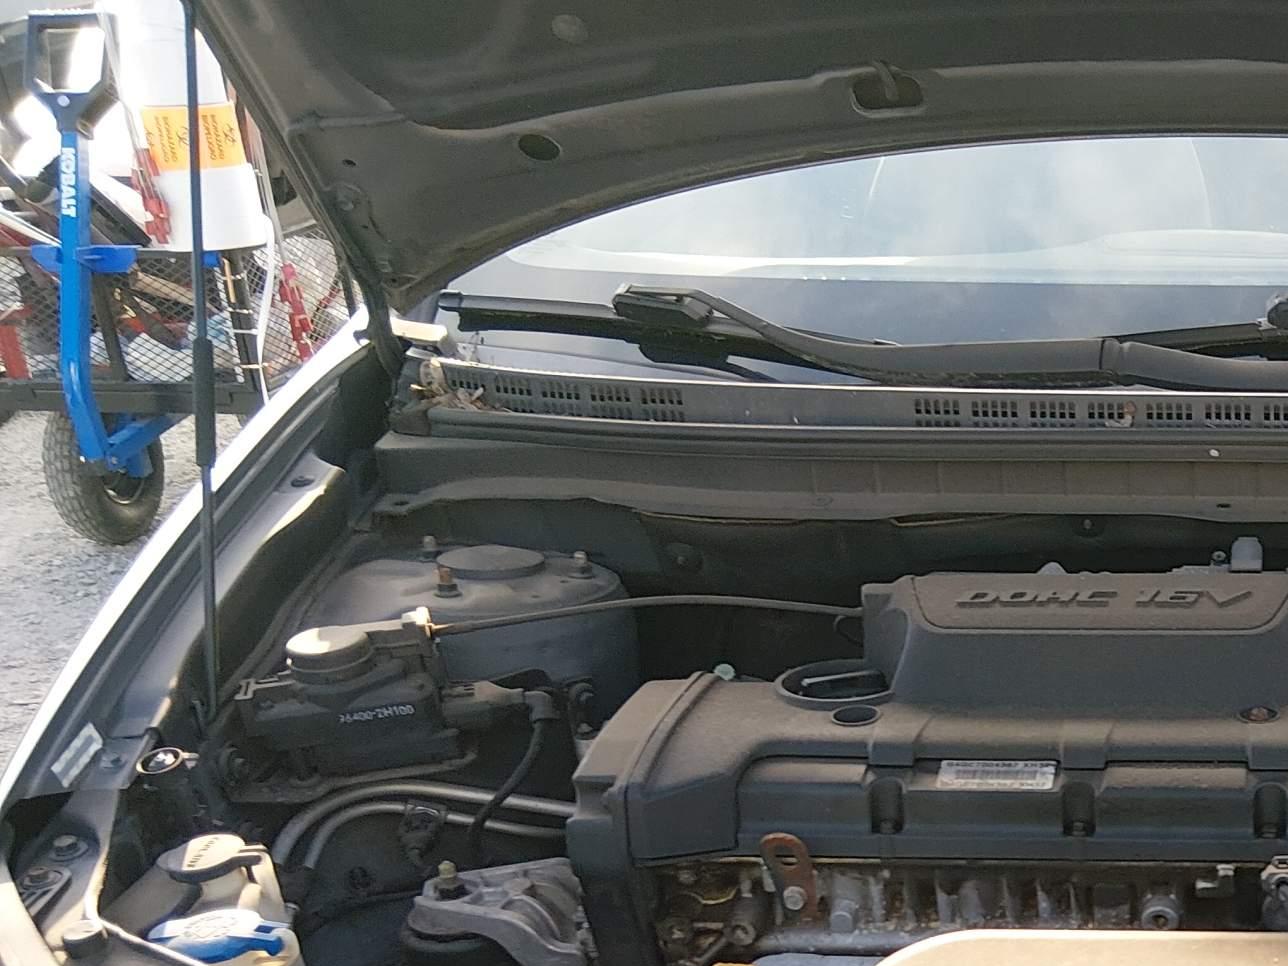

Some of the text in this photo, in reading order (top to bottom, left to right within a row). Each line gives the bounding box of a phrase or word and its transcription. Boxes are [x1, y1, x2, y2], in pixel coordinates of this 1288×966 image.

[60, 147, 77, 218] KOBALT
[955, 589, 1253, 608] DOHC 16V
